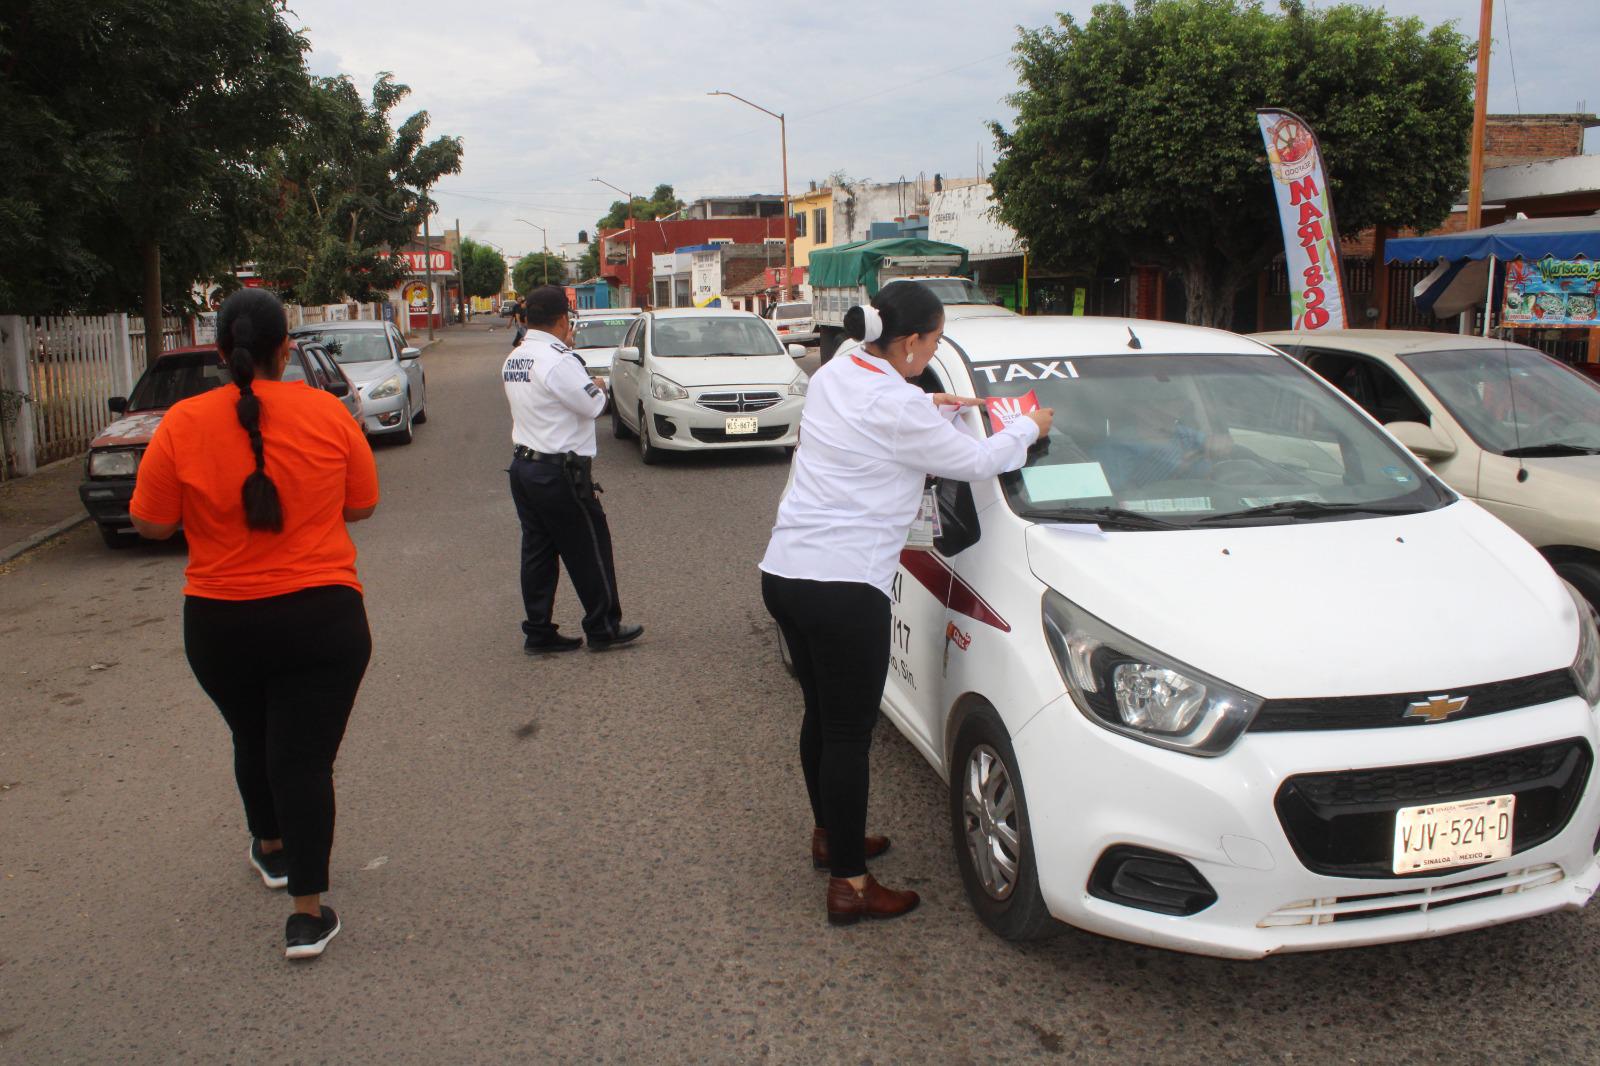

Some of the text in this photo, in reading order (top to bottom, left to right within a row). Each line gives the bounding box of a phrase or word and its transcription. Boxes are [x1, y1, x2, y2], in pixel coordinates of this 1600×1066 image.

[1536, 257, 1590, 284] Mariscos
[504, 371, 531, 382] MUNICIPAL
[973, 361, 1080, 383] TAXI
[1402, 813, 1509, 854] VJV-524-D
[1423, 857, 1451, 866] SINALOA
